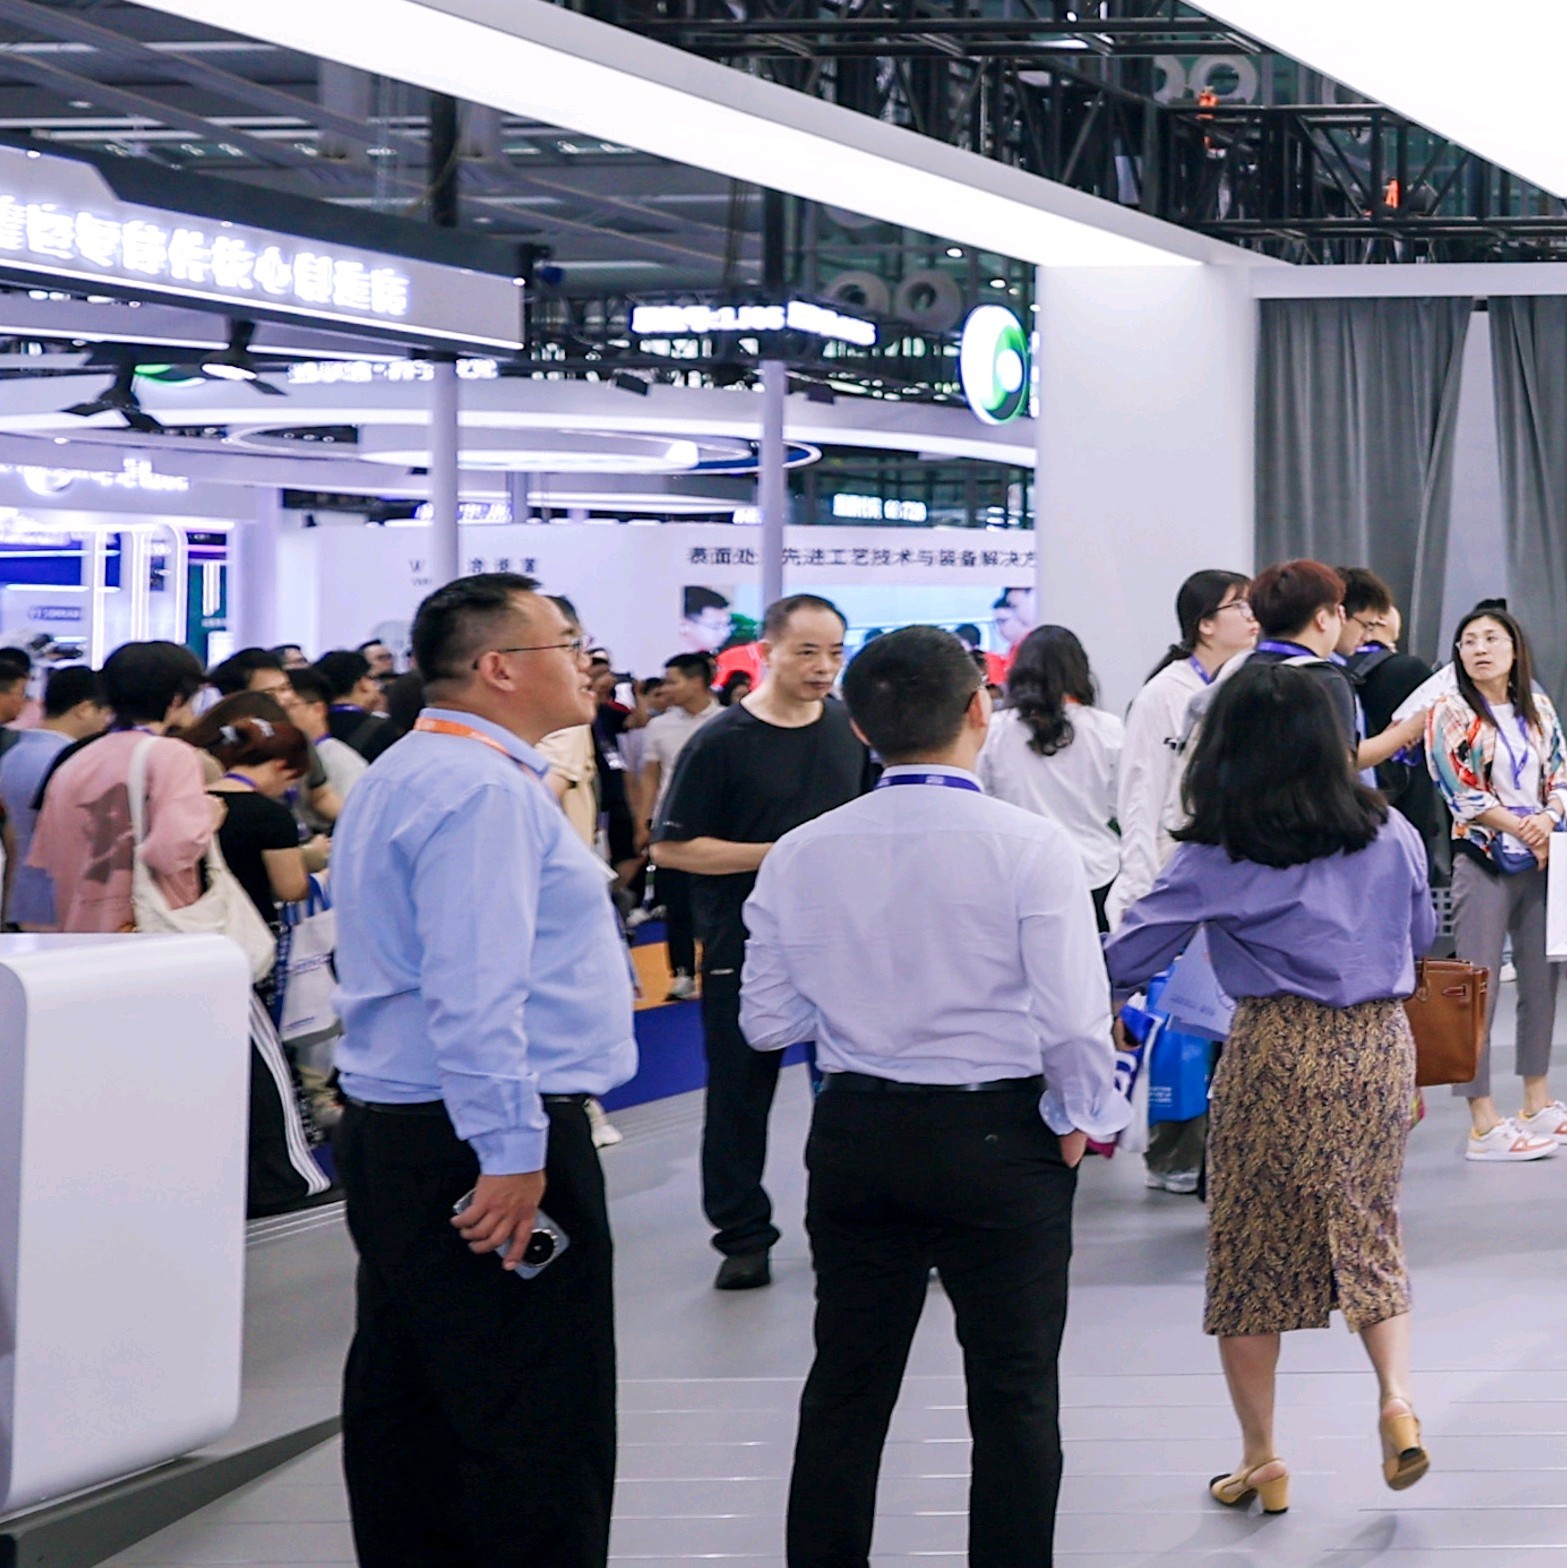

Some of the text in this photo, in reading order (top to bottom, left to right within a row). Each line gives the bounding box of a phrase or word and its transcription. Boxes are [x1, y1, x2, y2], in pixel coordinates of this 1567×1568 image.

[688, 546, 1037, 567] 表面处先进工艺技术与装备解决方
